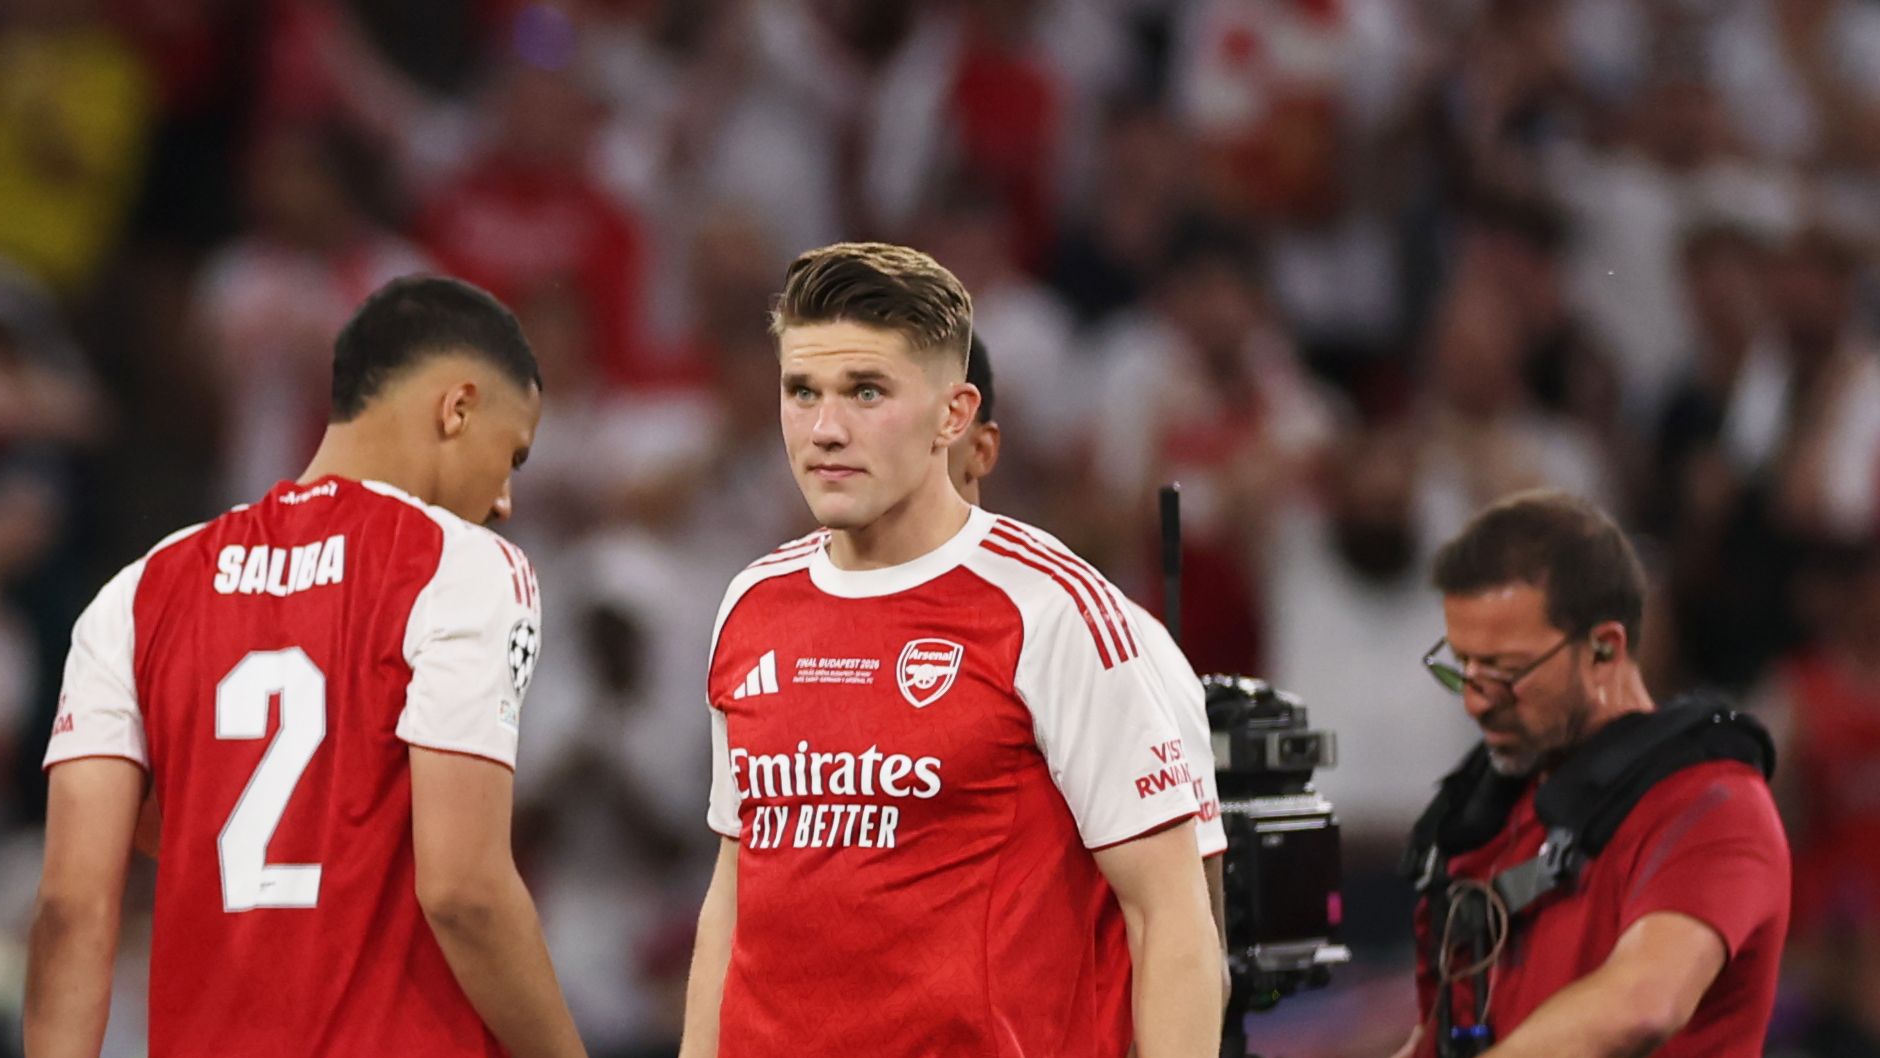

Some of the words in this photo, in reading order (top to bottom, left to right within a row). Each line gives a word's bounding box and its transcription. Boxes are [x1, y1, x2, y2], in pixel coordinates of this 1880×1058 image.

[213, 534, 345, 597] SALIBA
[795, 657, 817, 668] FINAL
[818, 658, 861, 669] BUDAPEST
[909, 649, 954, 662] Arsenal
[215, 645, 327, 913] 2
[730, 740, 942, 799] Emirates
[749, 805, 789, 849] FLY
[793, 804, 899, 849] BETTER
